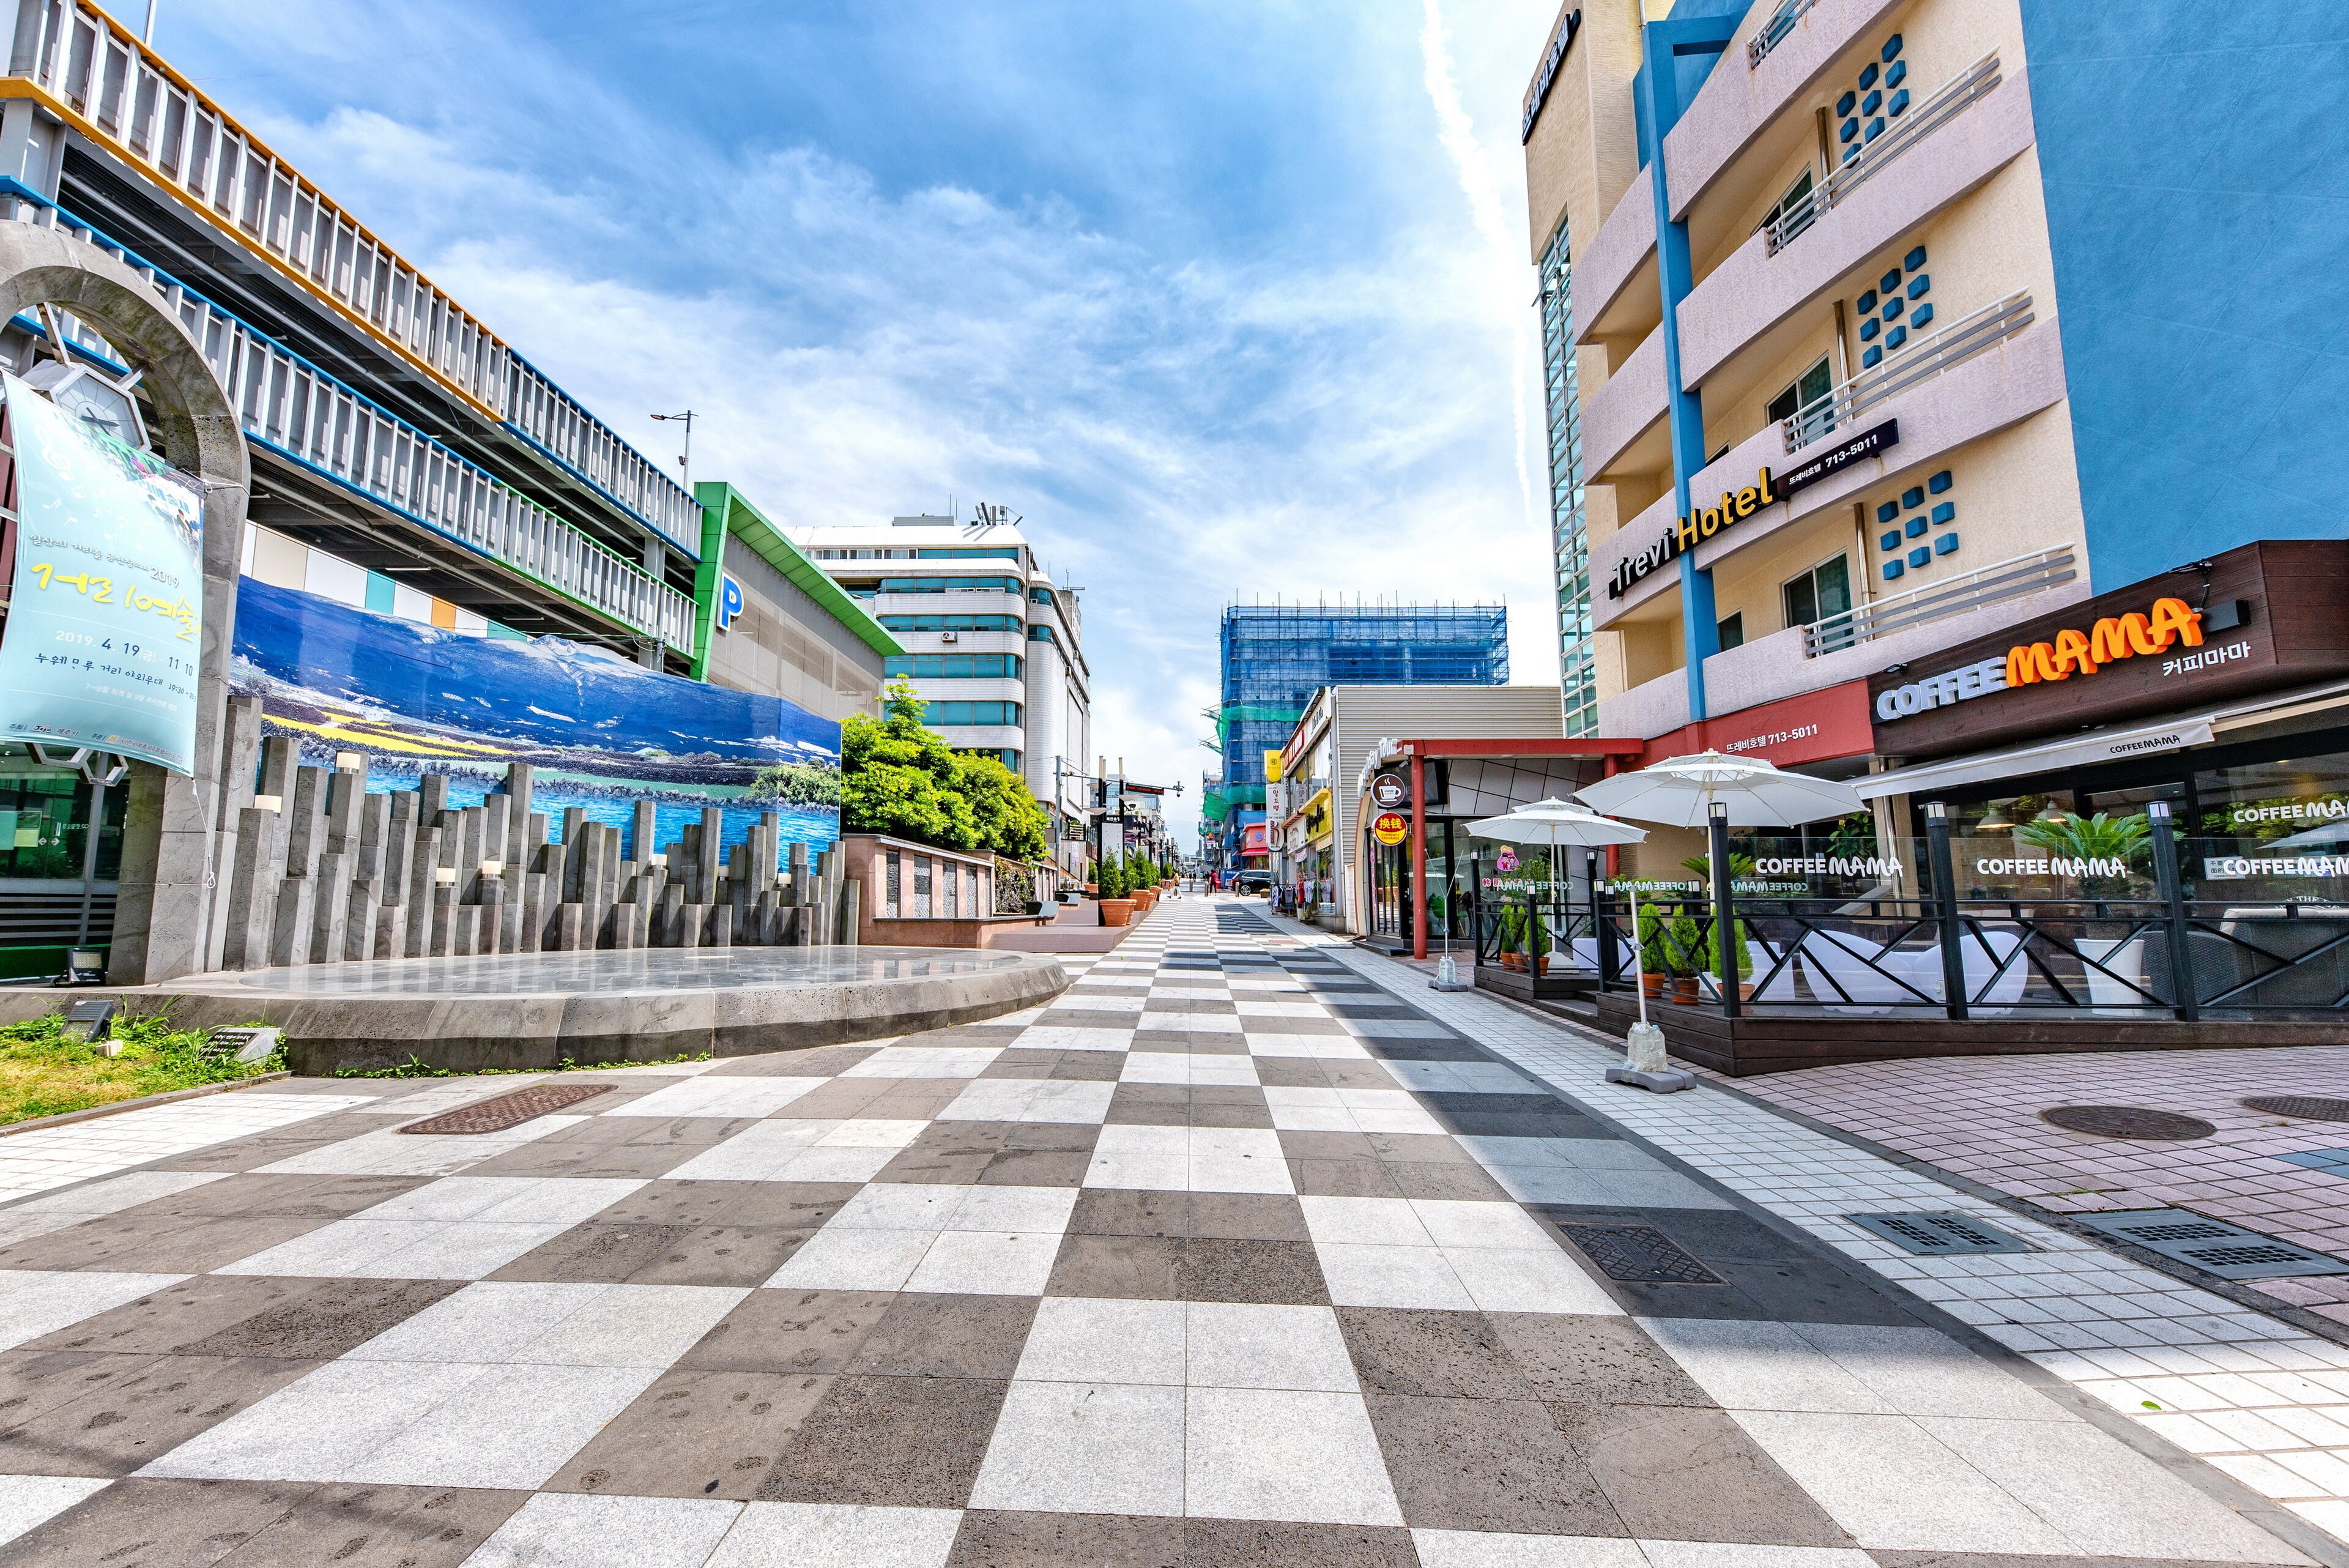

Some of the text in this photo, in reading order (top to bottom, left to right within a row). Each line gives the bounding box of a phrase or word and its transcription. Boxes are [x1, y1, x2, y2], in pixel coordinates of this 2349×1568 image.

[1789, 434, 1879, 485] 뜨레비호텔 713-5011
[1612, 467, 1773, 592] Trevi Hotel
[30, 534, 67, 547] 일상의
[72, 543, 103, 560] 거리를
[150, 567, 180, 589] 2019
[716, 571, 744, 632] P
[100, 664, 121, 675] 거리
[125, 671, 163, 685] 야외무대
[168, 683, 184, 694] 19:30
[1877, 597, 2203, 721] COFFEE MAMA
[2162, 641, 2251, 677] 커피마마
[1726, 723, 1818, 753] 뜨레비호텔 713-5011
[1379, 817, 1402, 830] 换钱
[2306, 799, 2349, 818] MA
